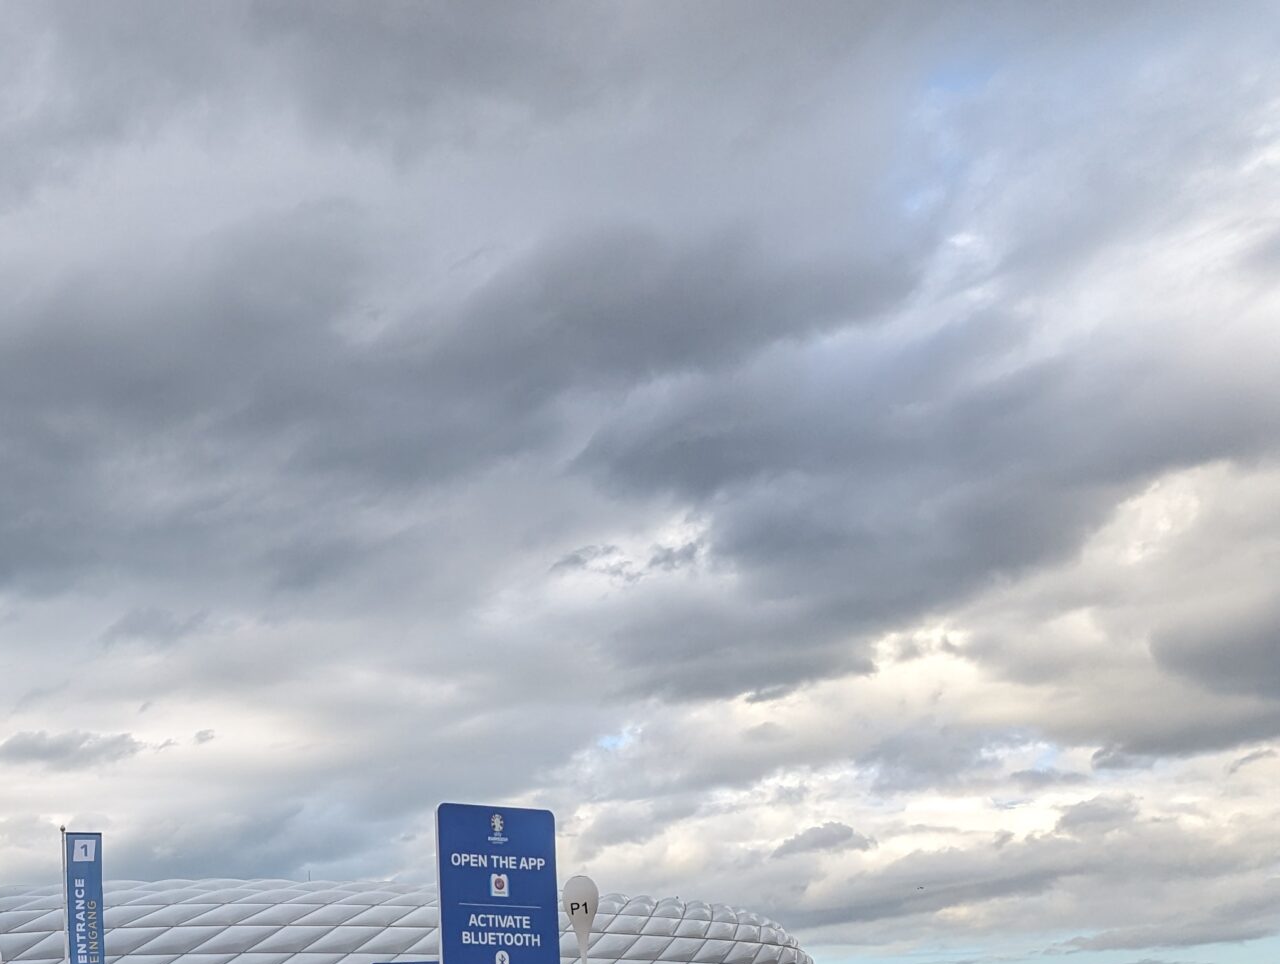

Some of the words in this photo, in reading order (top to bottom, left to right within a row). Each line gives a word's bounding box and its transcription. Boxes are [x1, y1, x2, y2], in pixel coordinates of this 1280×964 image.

[80, 844, 89, 857] 1
[451, 853, 488, 868] OPEN
[491, 855, 517, 869] THE
[519, 857, 546, 871] APP
[570, 902, 589, 916] P1
[74, 878, 88, 964] ENTRANCE
[468, 914, 531, 929] ACTIVATE
[87, 900, 100, 964] EINGANG
[462, 931, 541, 947] BLUETOOTH
